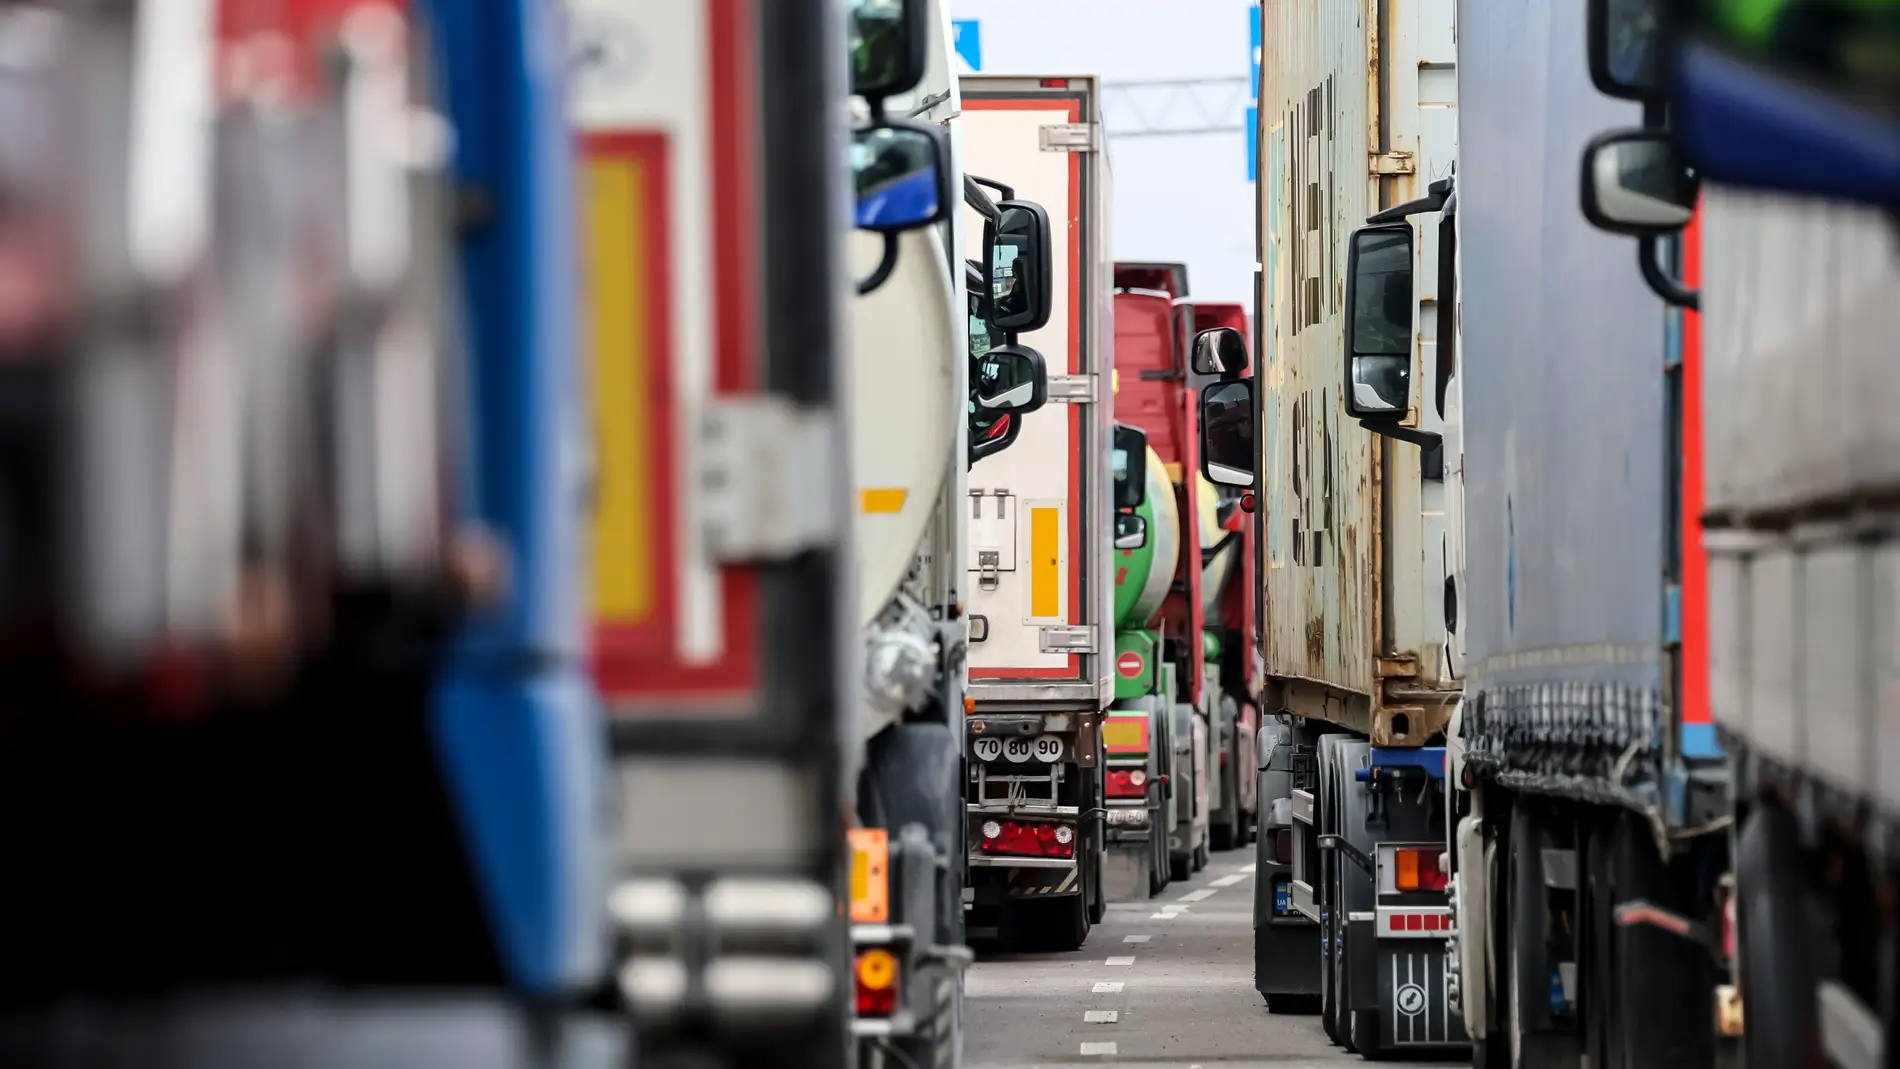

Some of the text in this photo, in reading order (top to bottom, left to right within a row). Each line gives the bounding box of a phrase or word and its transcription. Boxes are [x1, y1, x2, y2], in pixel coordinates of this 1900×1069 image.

[979, 740, 1059, 755] 70 80 90
